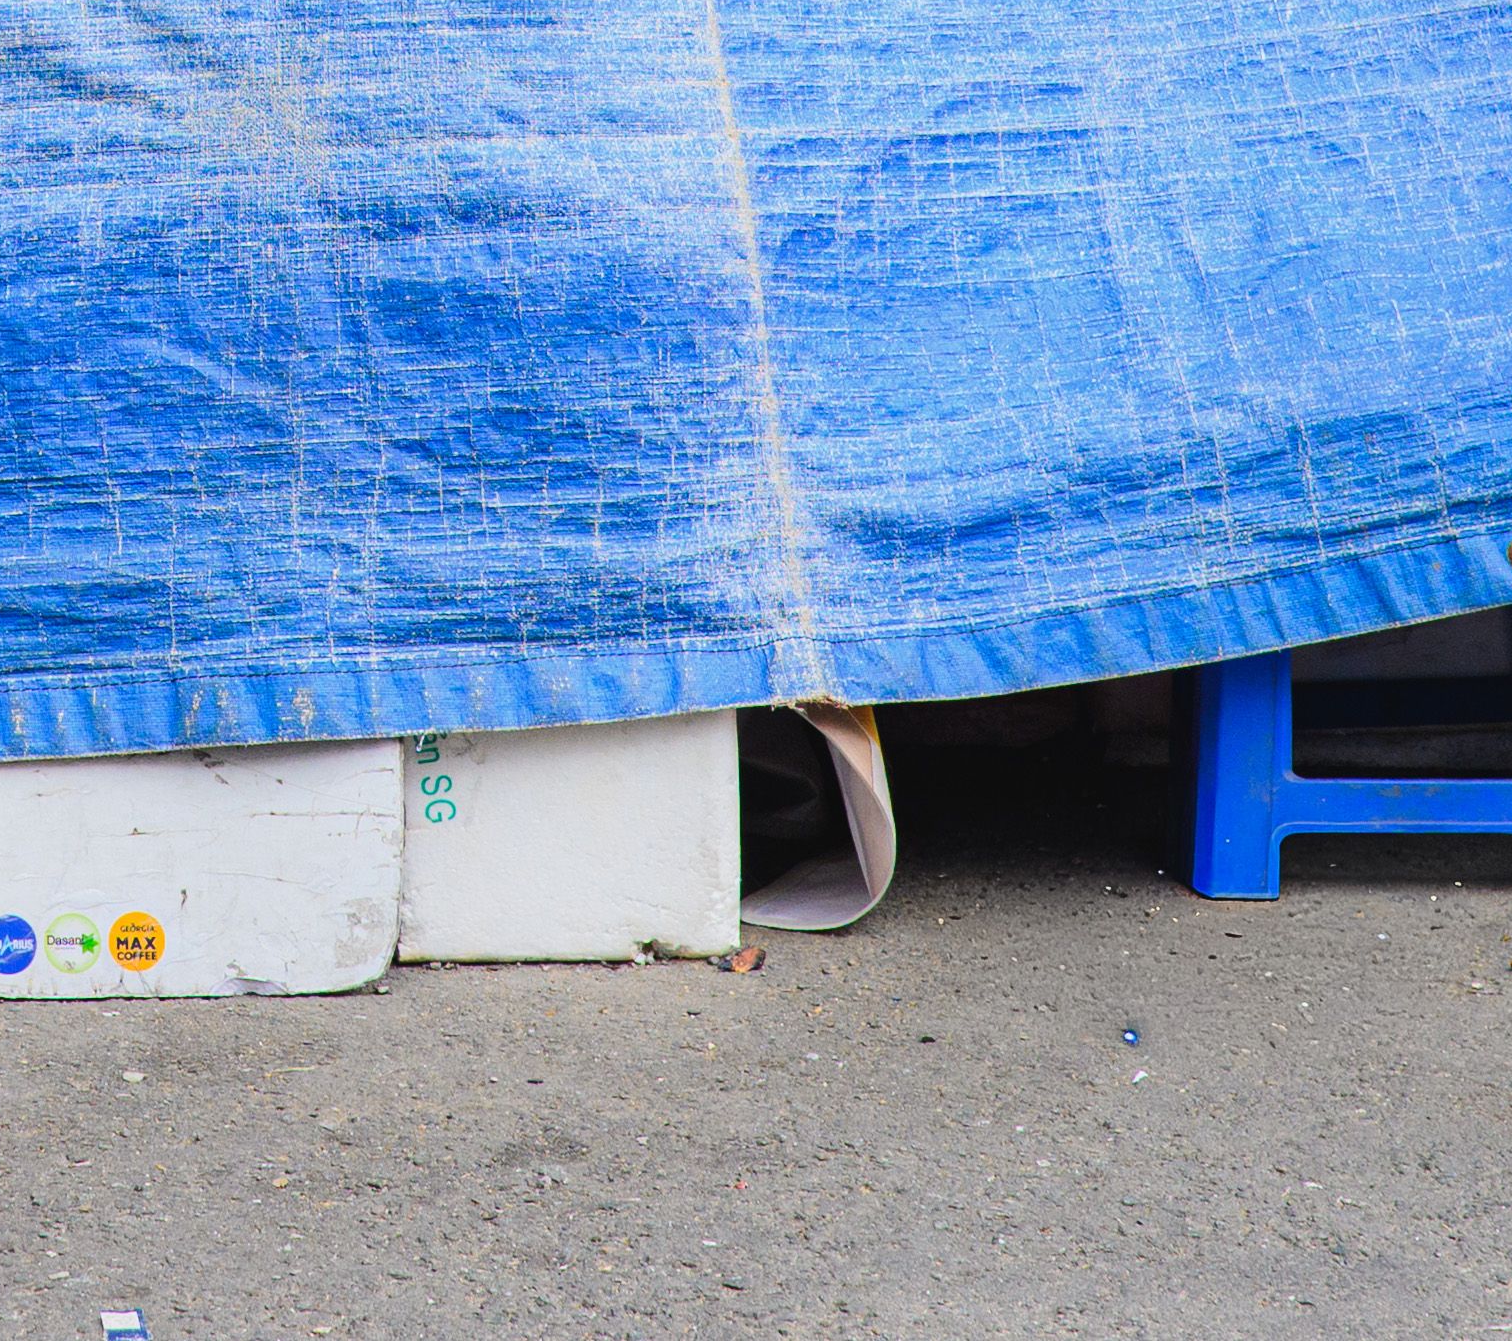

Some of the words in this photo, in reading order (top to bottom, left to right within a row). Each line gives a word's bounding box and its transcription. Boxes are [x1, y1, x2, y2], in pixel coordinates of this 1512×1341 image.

[420, 774, 457, 824] SG
[116, 936, 157, 951] MAX
[116, 951, 158, 962] COFFEE
